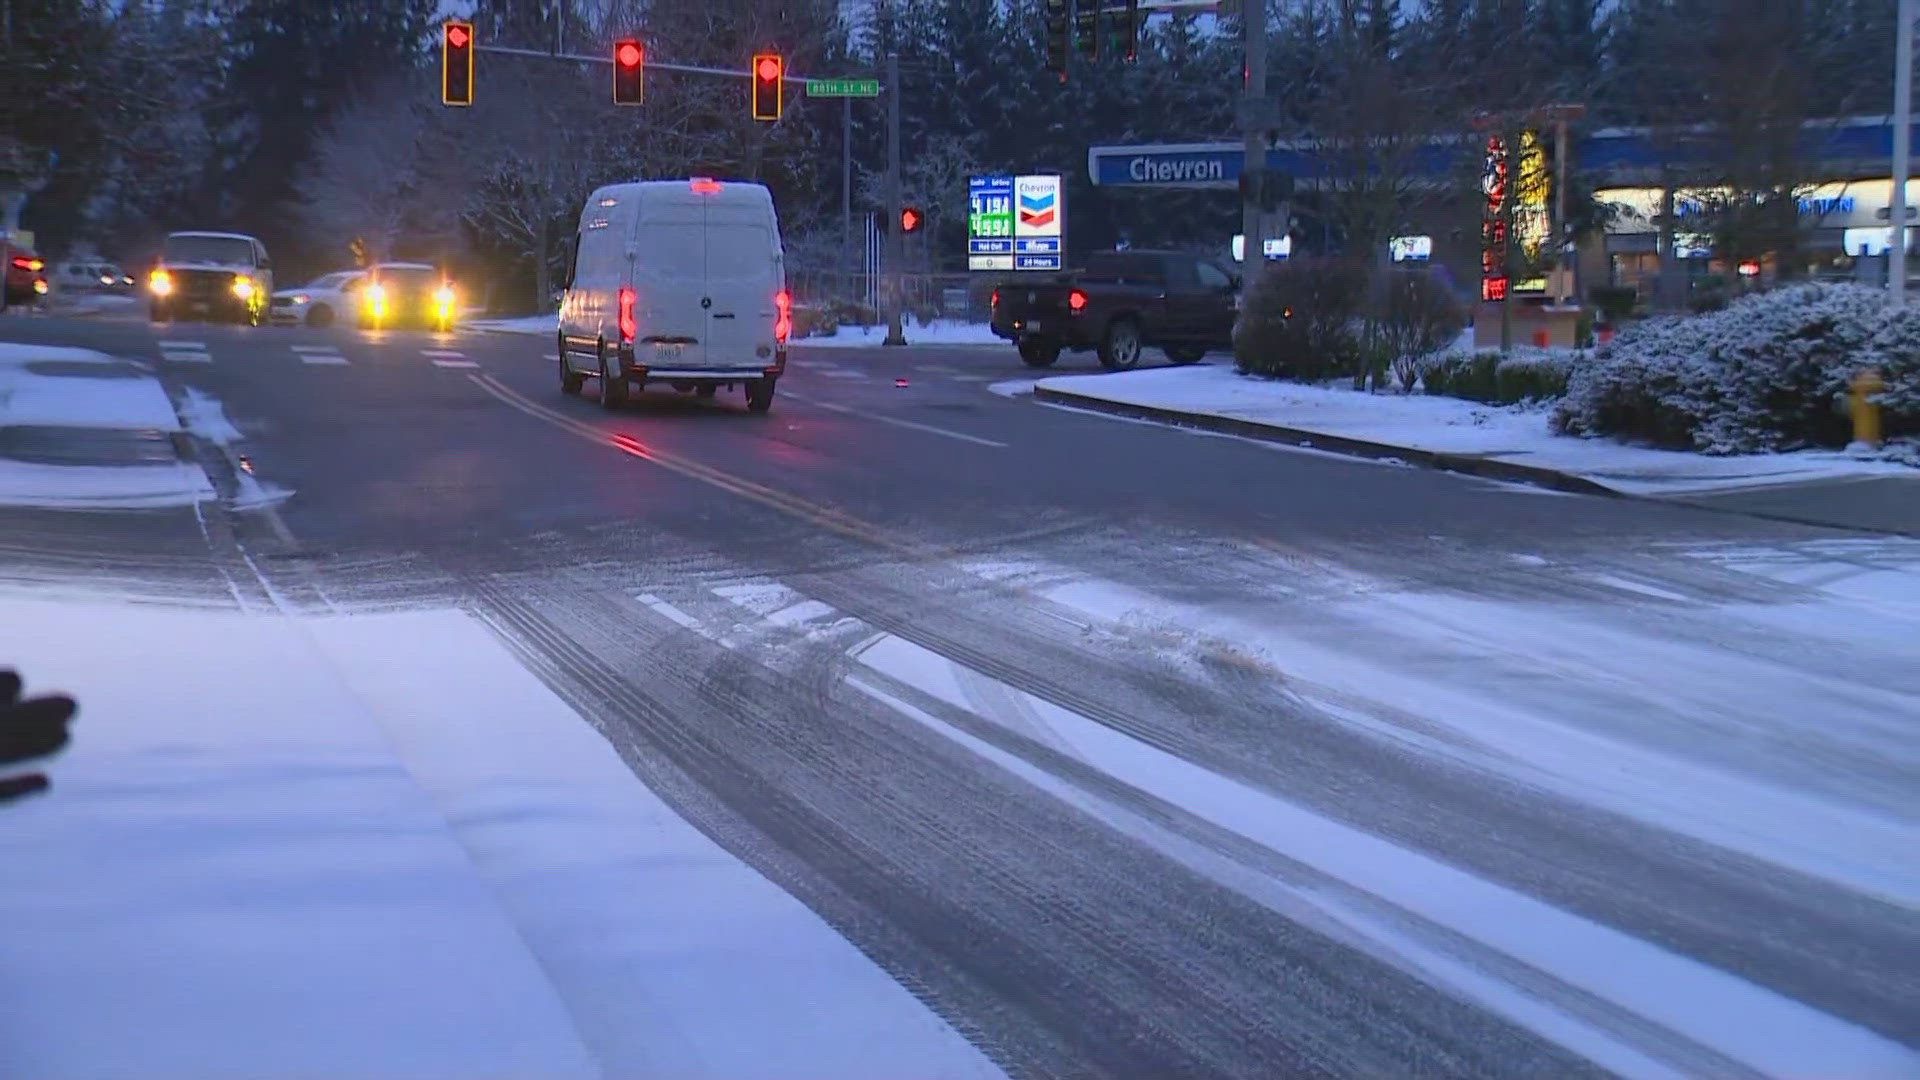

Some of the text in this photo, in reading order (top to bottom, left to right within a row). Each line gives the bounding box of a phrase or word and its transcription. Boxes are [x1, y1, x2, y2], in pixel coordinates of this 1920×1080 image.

[813, 82, 872, 94] 88TH ST NE
[1129, 156, 1223, 181] Chevron
[1019, 183, 1055, 193] Chevron
[1023, 258, 1052, 267] 24 Hours
